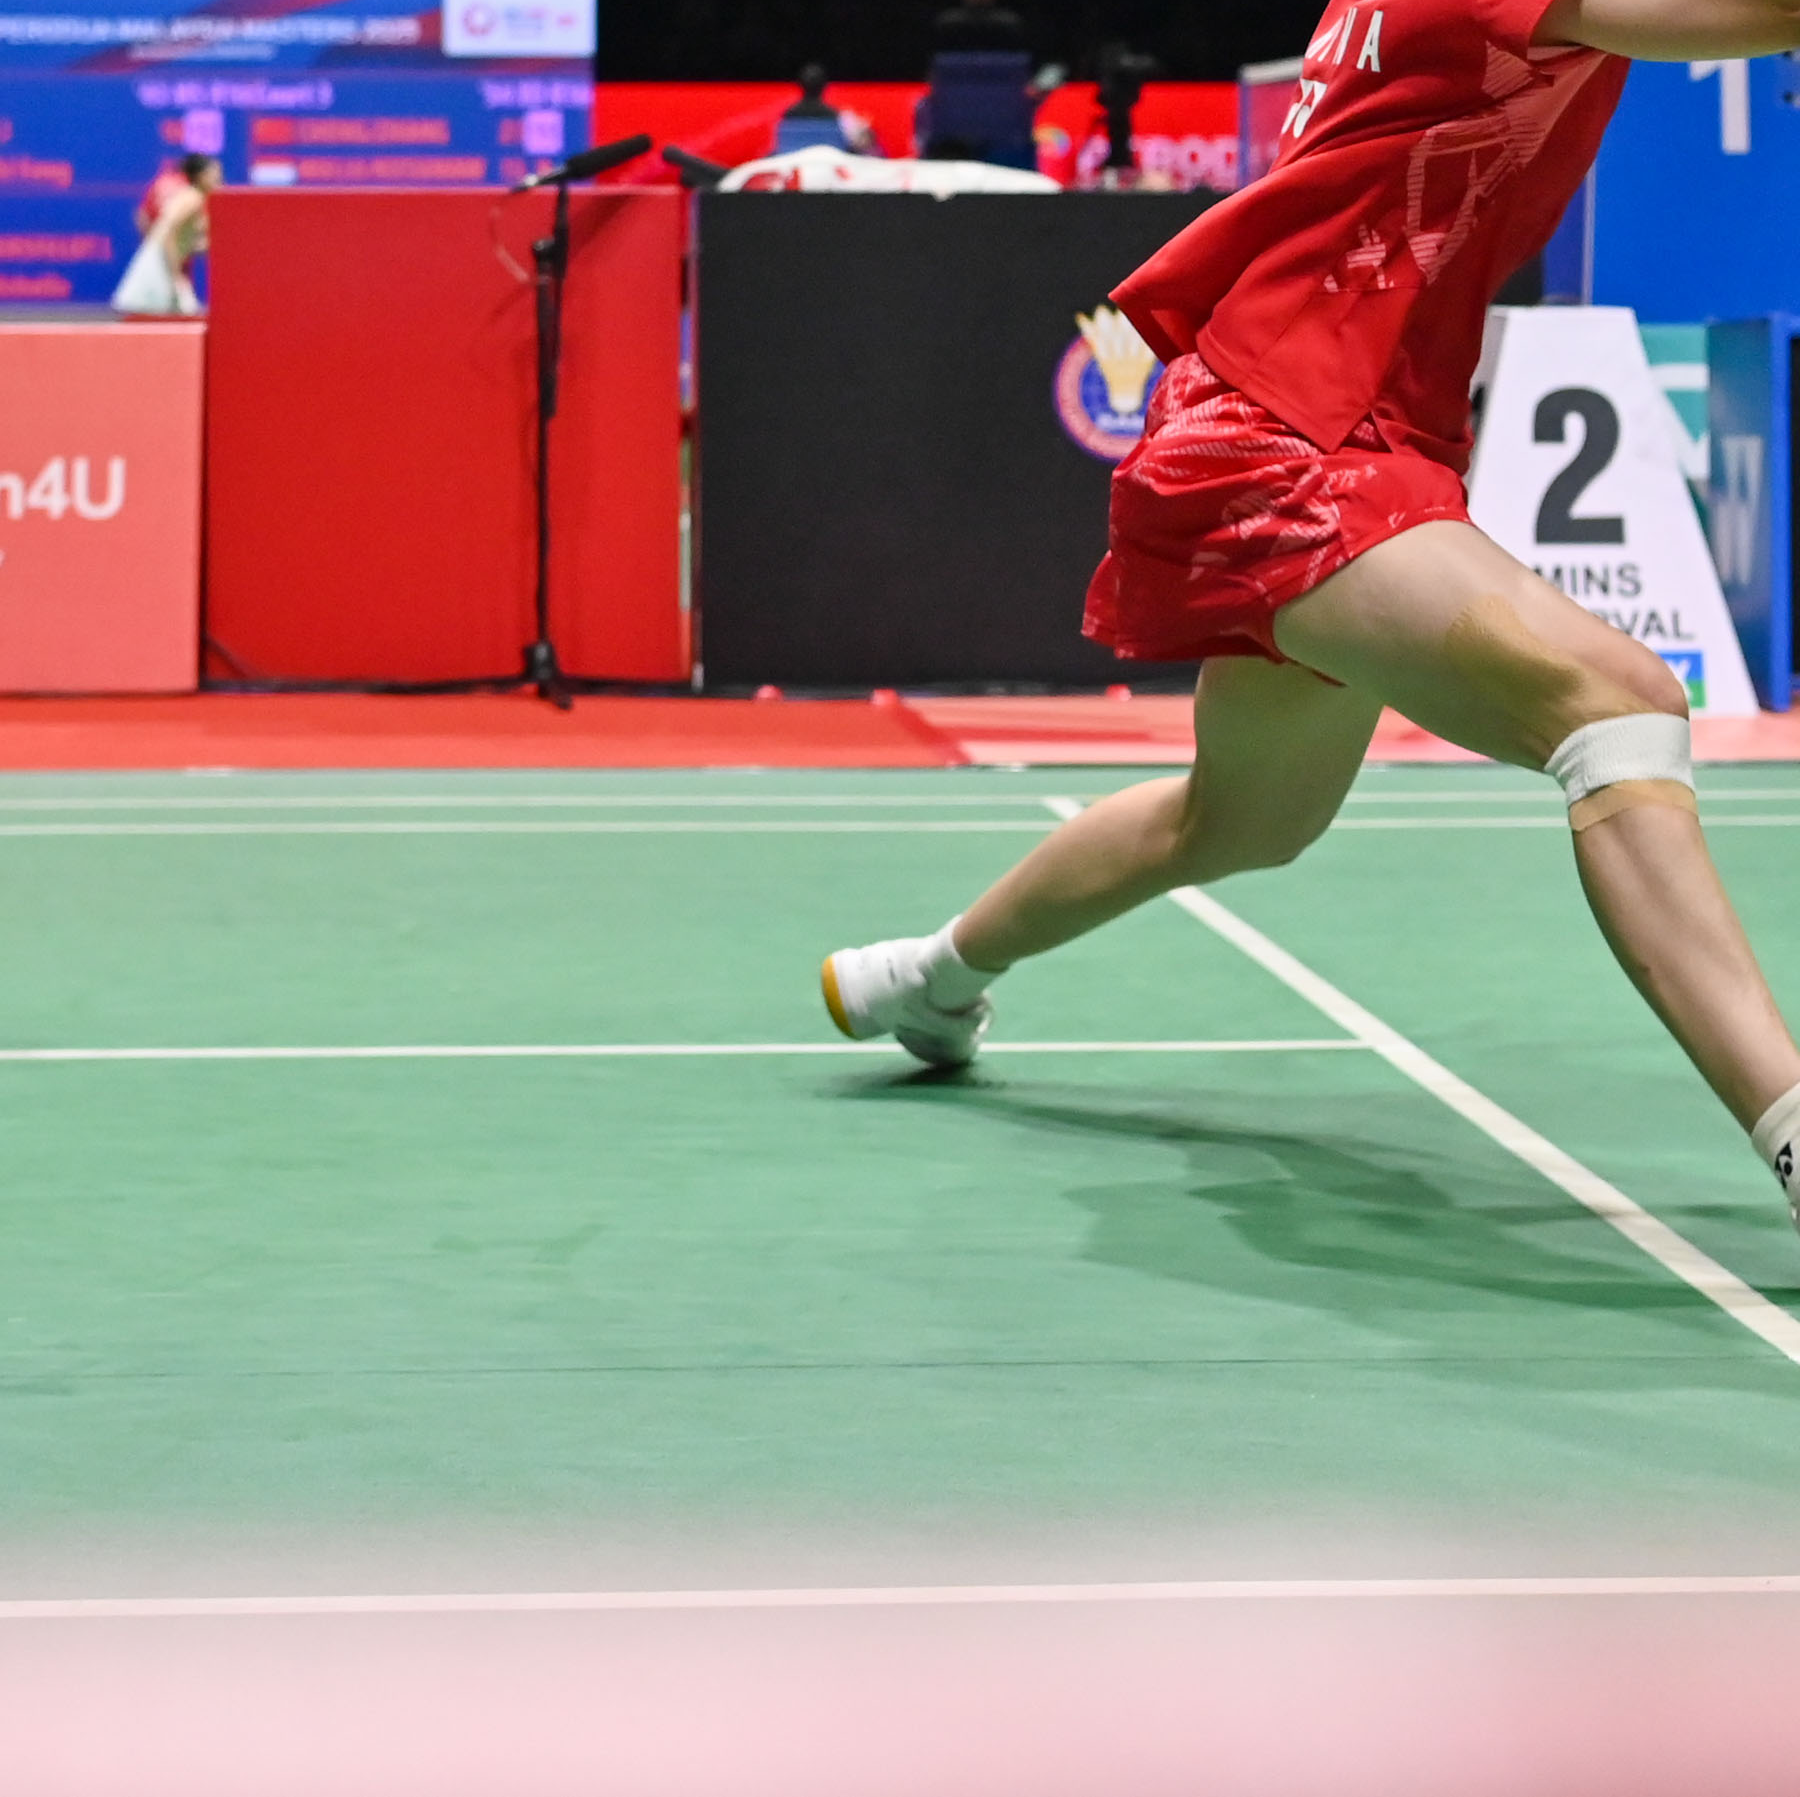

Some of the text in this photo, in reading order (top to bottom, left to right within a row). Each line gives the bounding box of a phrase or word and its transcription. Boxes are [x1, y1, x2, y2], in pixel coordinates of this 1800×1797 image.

[1689, 59, 1750, 154] 1
[1533, 387, 1626, 545] 2
[1590, 608, 1696, 641] VAL
